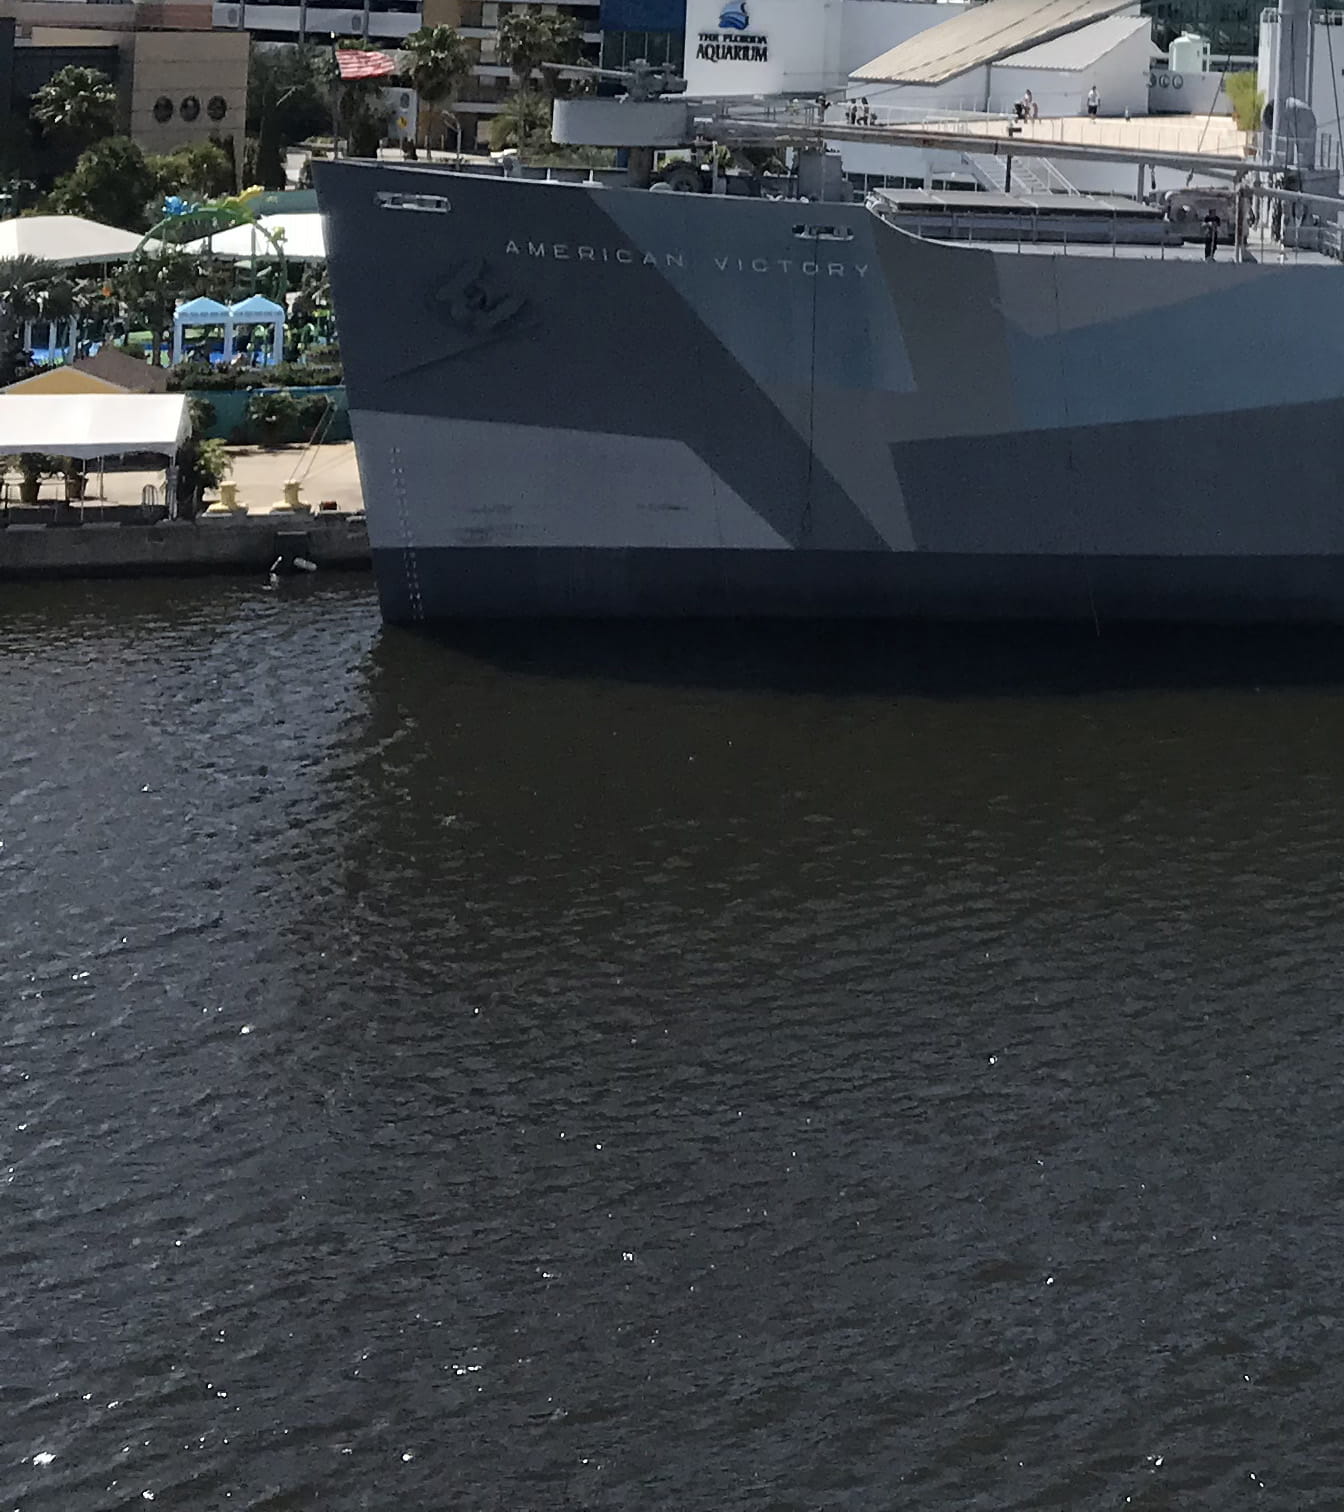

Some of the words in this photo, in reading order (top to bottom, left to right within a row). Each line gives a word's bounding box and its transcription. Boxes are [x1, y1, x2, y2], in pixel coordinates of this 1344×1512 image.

[698, 33, 719, 42] THE
[696, 44, 768, 63] AQUARIUM
[505, 240, 685, 267] AMERICAN
[714, 256, 870, 278] VICTORY
